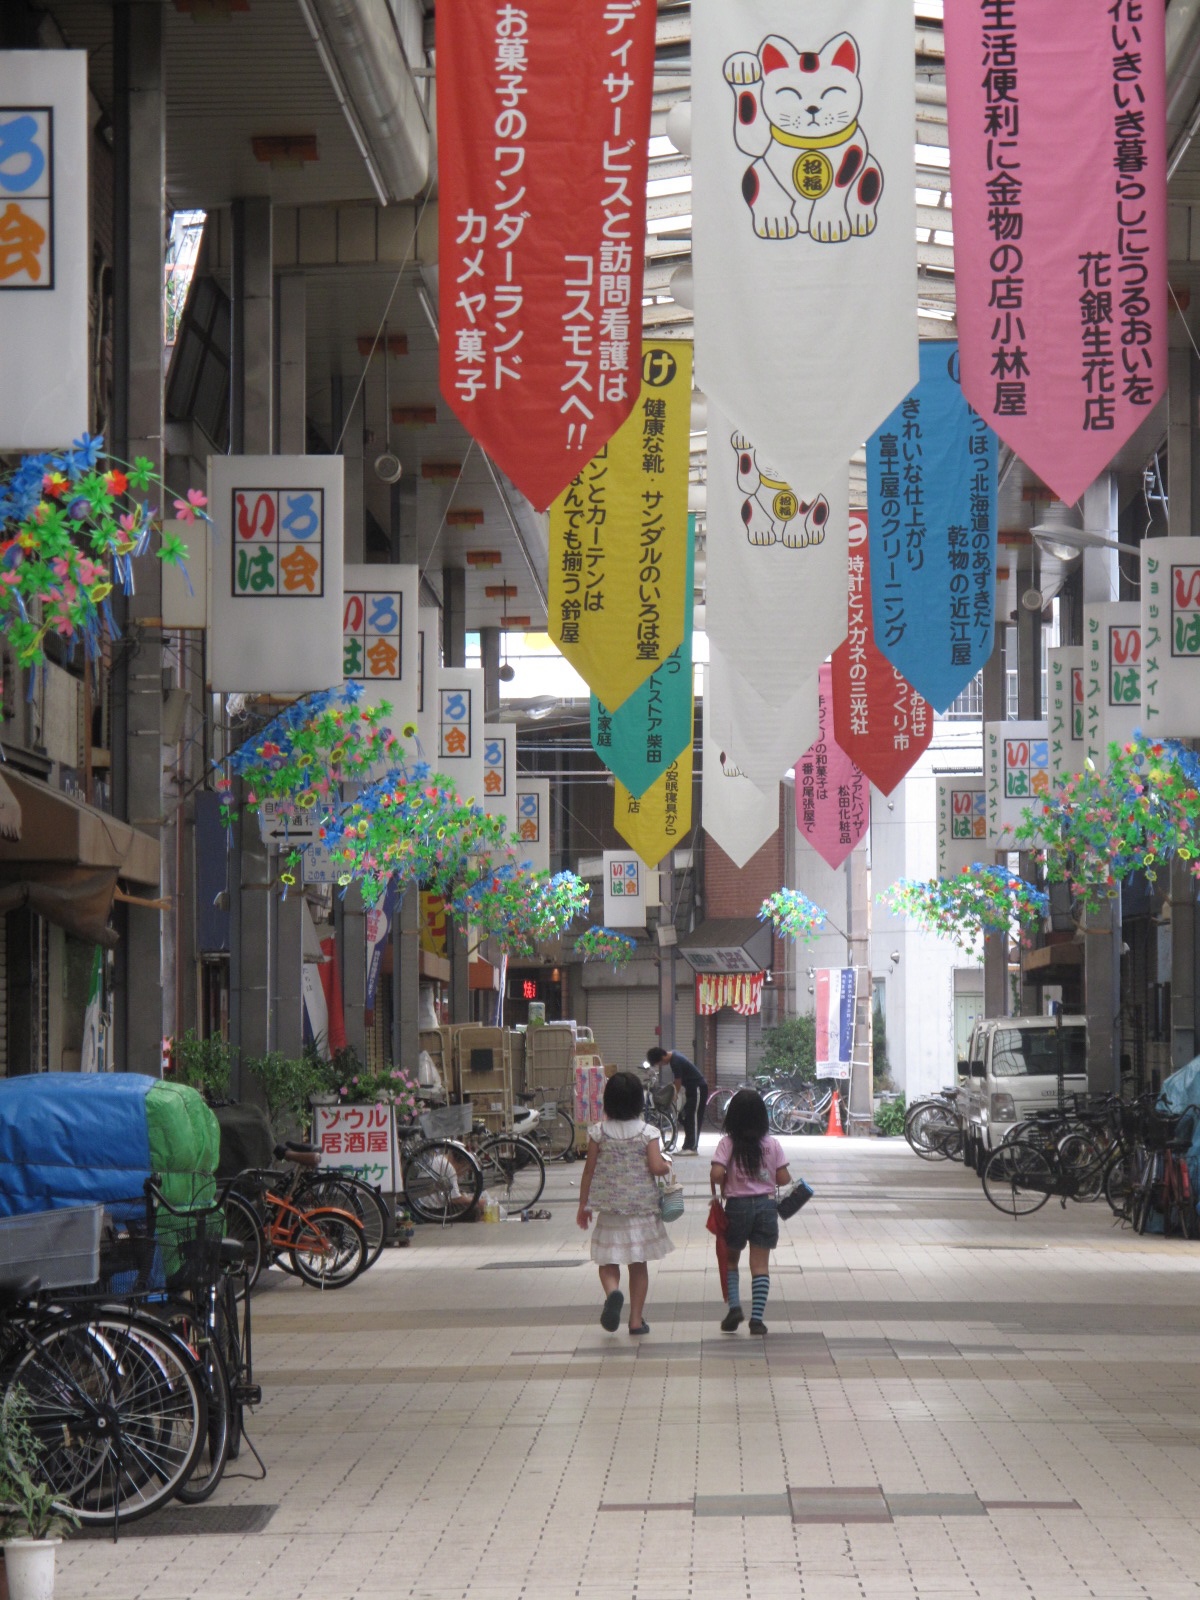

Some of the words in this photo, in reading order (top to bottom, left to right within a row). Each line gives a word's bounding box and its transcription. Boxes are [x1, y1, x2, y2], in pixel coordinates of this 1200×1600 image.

[492, 3, 530, 390] お菓子のワンダーランド
[454, 208, 487, 402] カメヤ菓子
[1078, 252, 1117, 432] 花銀生花店
[236, 492, 319, 540] いろ
[237, 544, 319, 592] は会
[879, 432, 908, 648] 富士屋のクリーニング
[947, 525, 972, 667] 乾物の近江屋
[1145, 557, 1161, 720] ショップメイト
[445, 694, 467, 721] ろ
[445, 726, 467, 754] 会
[1087, 618, 1100, 759] ショップメイト
[321, 1109, 387, 1129] ソウル
[321, 1131, 388, 1154] 居酒屋
